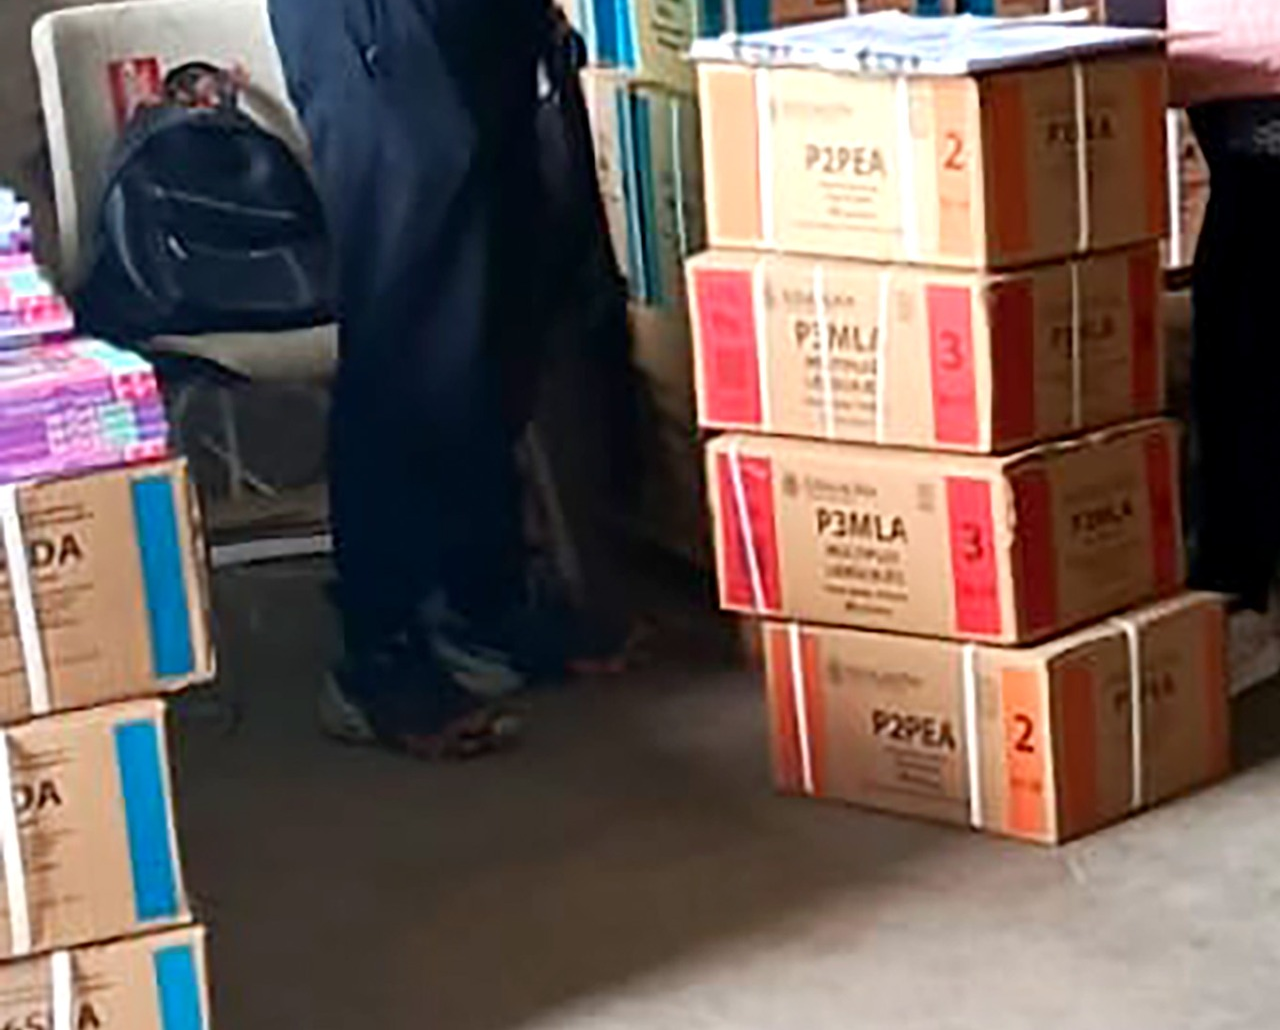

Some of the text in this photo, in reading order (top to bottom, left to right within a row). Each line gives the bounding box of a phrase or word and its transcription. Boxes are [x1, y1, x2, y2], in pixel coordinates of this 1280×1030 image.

[804, 143, 888, 180] P2PEA
[943, 130, 966, 172] 2
[939, 330, 966, 371] 3
[816, 507, 909, 545] P3MLA
[962, 522, 983, 563] 3
[871, 708, 957, 751] P2PEA
[1013, 713, 1035, 754] 2
